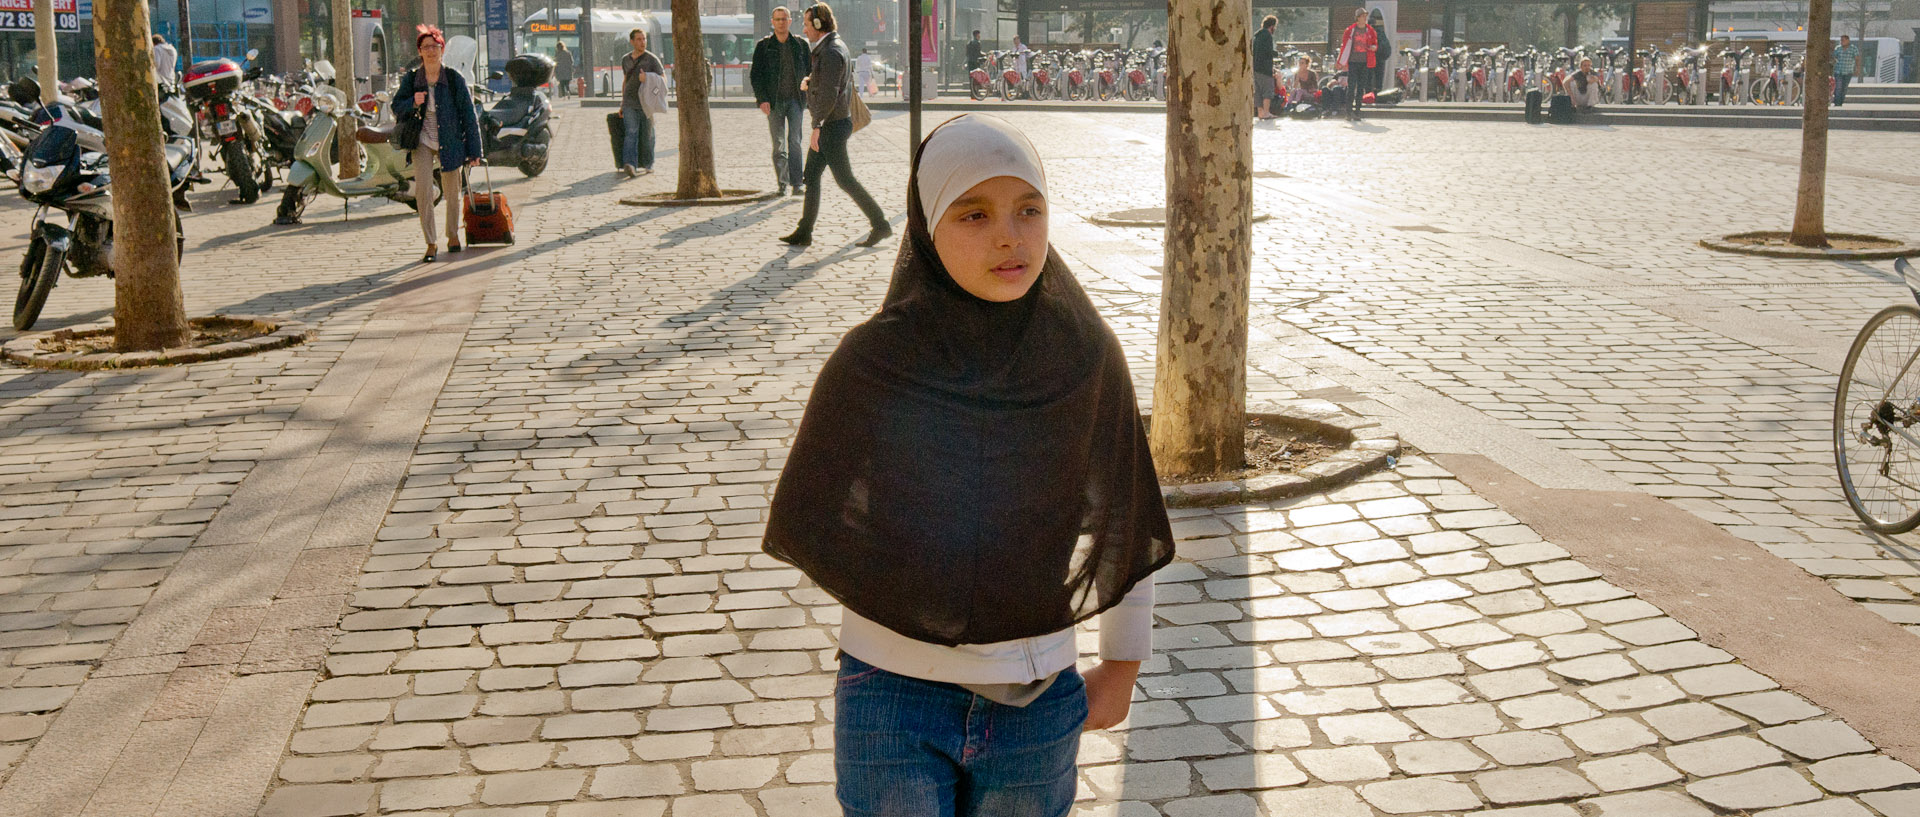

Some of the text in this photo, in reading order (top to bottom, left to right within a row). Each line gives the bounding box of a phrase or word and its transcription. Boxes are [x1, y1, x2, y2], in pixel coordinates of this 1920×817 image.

[0, 0, 27, 8] RICE
[17, 12, 35, 28] 83
[59, 14, 77, 28] 08
[531, 23, 540, 32] C2
